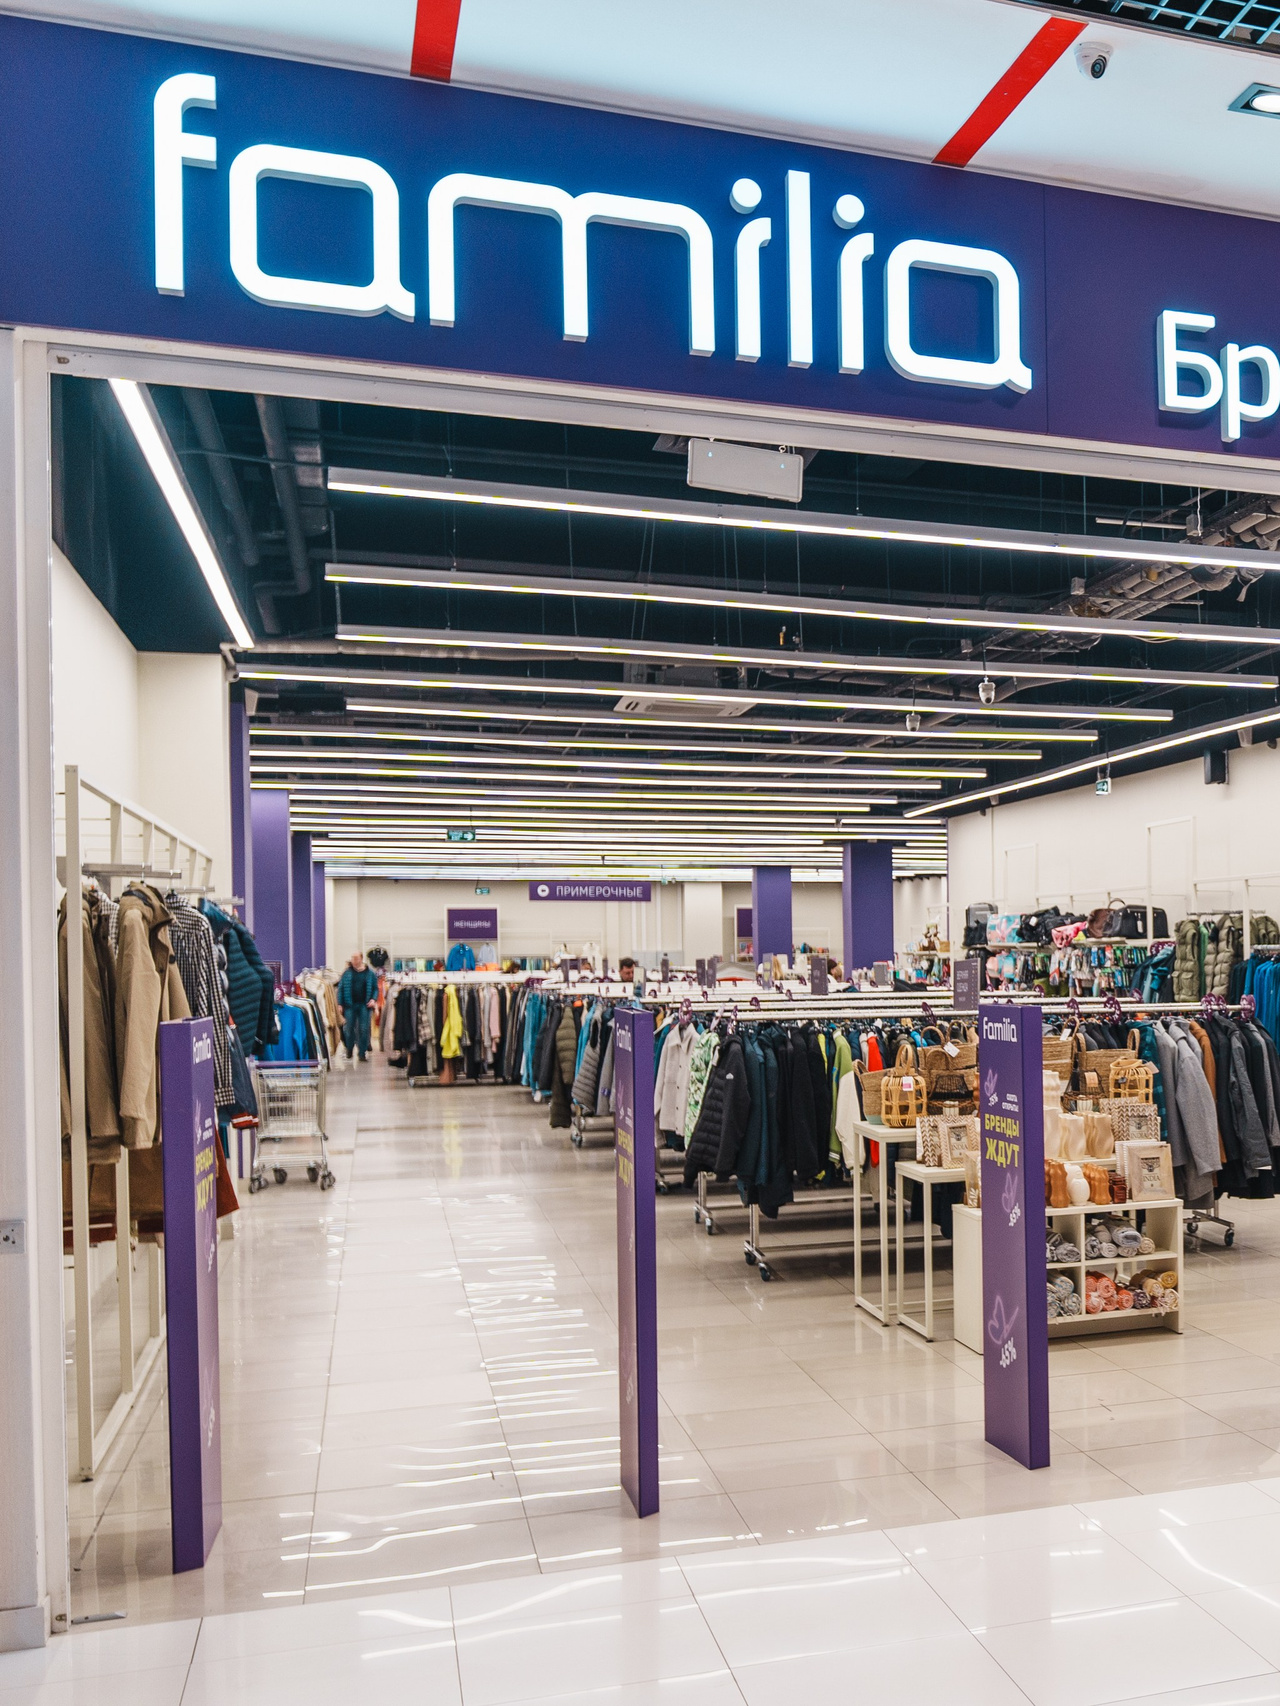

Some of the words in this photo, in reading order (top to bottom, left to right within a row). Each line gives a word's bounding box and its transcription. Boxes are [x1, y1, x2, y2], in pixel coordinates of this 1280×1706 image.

[152, 72, 1034, 394] familia
[556, 886, 643, 898] ПРИМЕРОЧНЫЕ
[983, 1016, 1018, 1042] familia
[984, 1113, 1020, 1139] БРЕНДЫ
[985, 1137, 1020, 1168] ЖДУТ
[1143, 1174, 1161, 1182] INDIA
